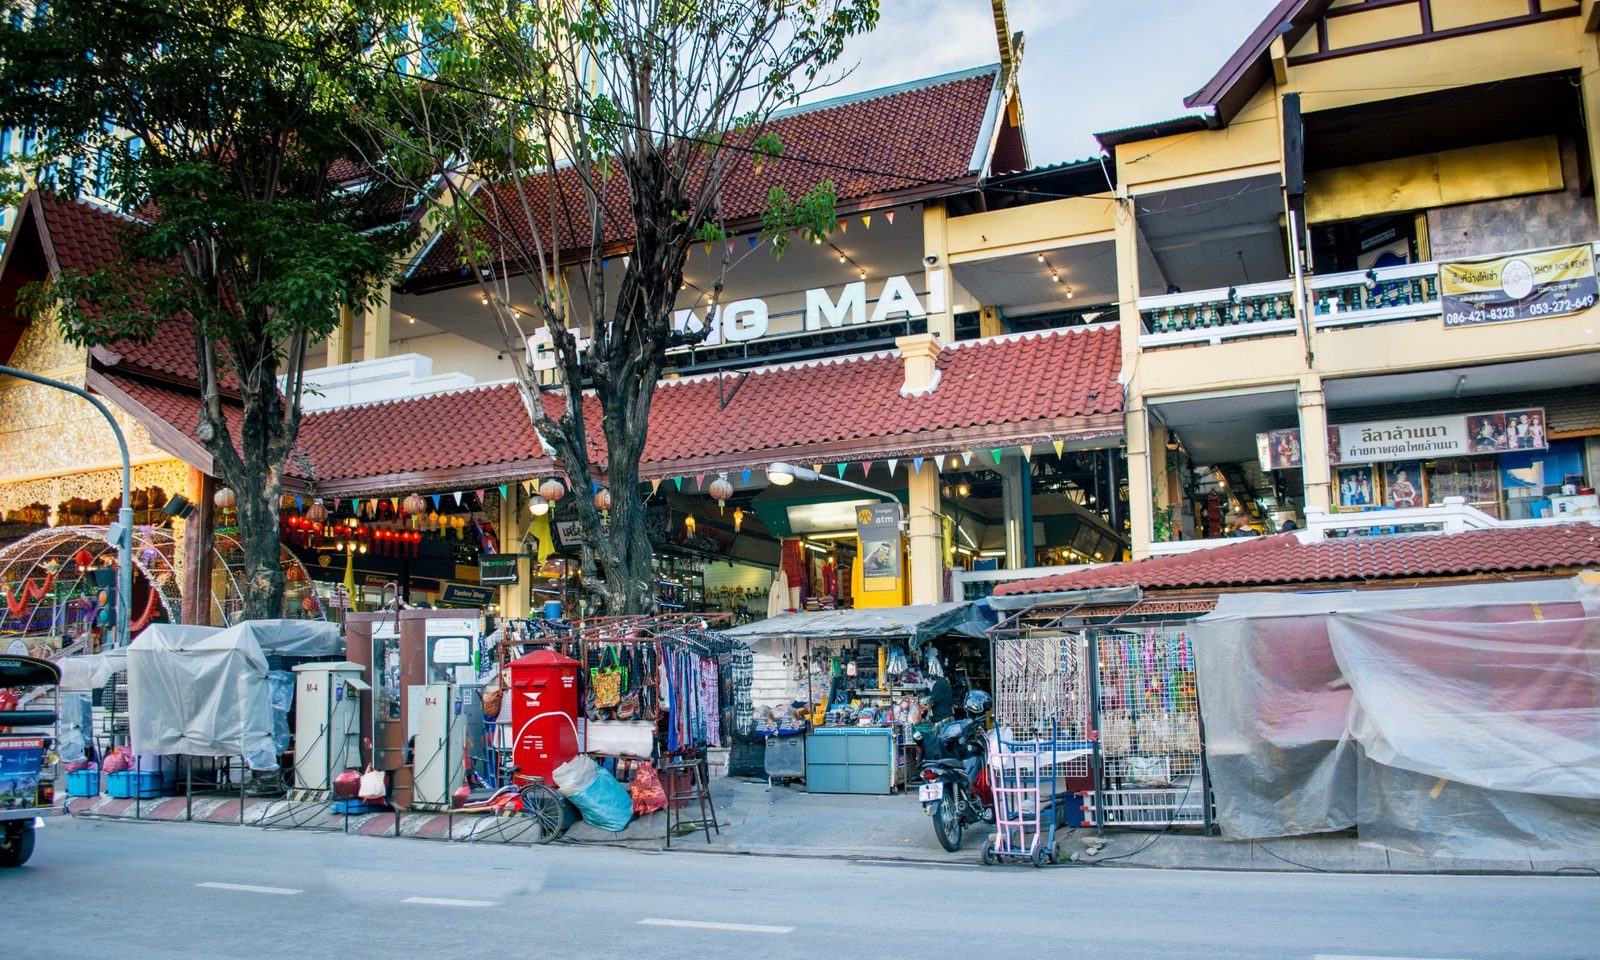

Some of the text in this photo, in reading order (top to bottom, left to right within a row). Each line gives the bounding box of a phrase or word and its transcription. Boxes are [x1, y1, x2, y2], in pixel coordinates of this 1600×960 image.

[1534, 258, 1589, 275] SHOP FOR RENT
[806, 270, 945, 331] MAI
[1530, 295, 1594, 315] 053-272-649
[1446, 307, 1515, 325] 086-421-8328
[1361, 425, 1447, 442] ลีลาล้านนา
[1350, 440, 1458, 456] ถ่ายภาพชุดไทยล้านนา
[875, 516, 893, 524] atm
[306, 683, 318, 693] M-4
[425, 697, 437, 706] M-4
